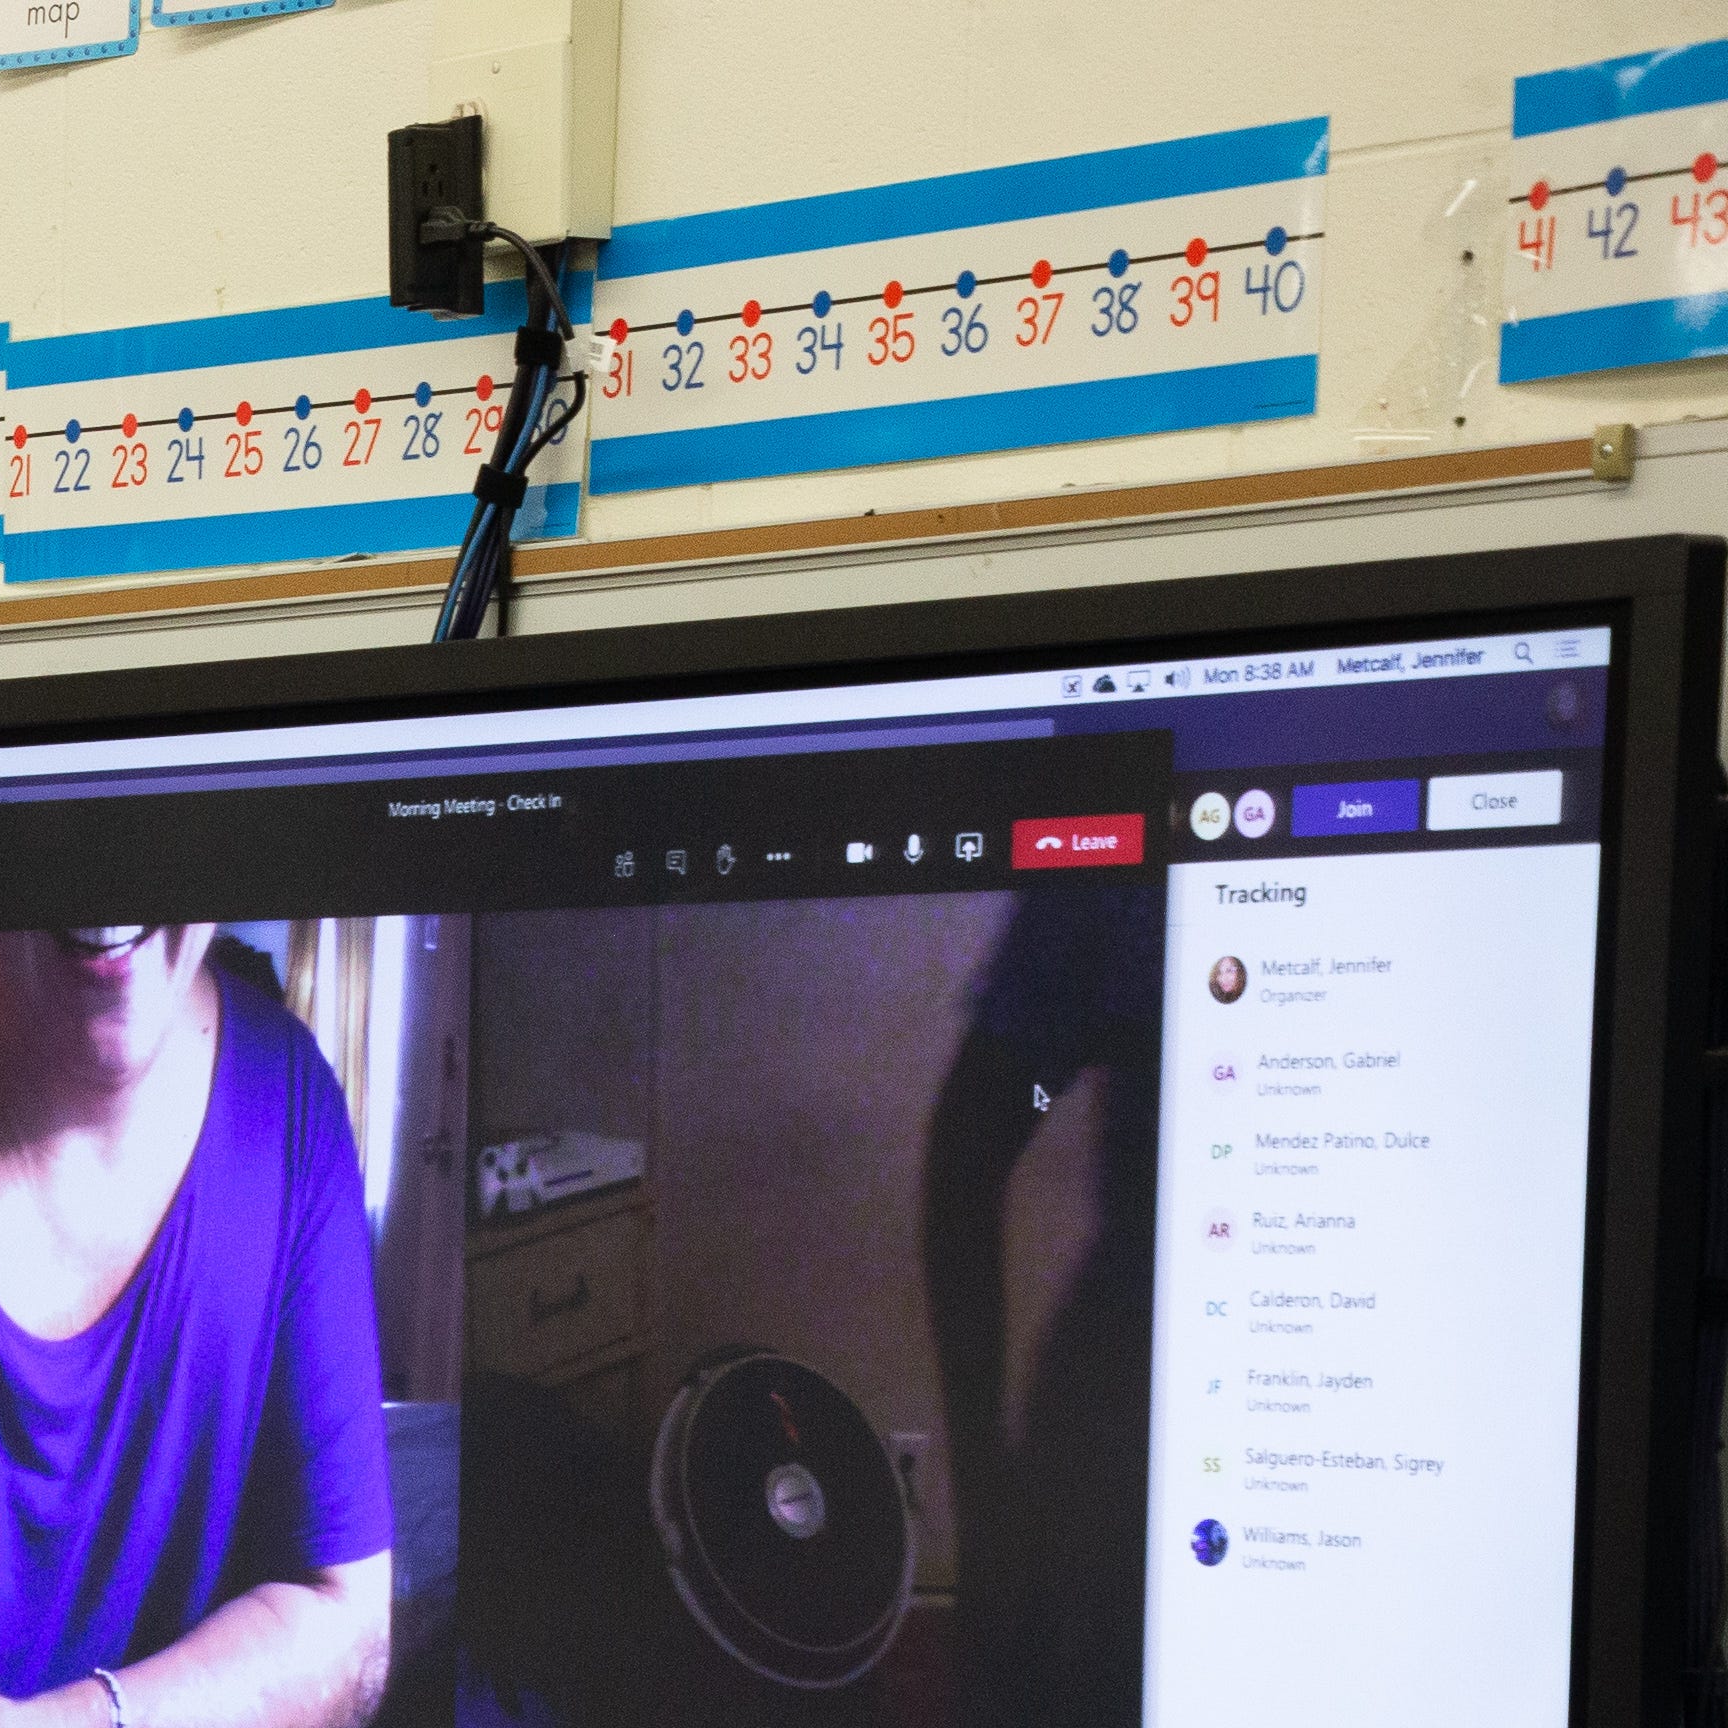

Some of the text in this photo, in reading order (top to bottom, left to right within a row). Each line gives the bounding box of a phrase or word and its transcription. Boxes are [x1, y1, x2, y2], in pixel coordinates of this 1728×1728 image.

[26, 2, 81, 35] map
[662, 260, 1305, 391] 32 33 34 35 36 37 38 39 40
[1204, 666, 1237, 683] Mon
[1244, 662, 1280, 681] 8:38
[1287, 660, 1314, 679] AM
[1412, 648, 1481, 669] Jennifer
[1337, 800, 1372, 817] Join
[1471, 792, 1517, 810] Close
[1071, 832, 1117, 850] Leave
[1216, 883, 1305, 906] Tracking
